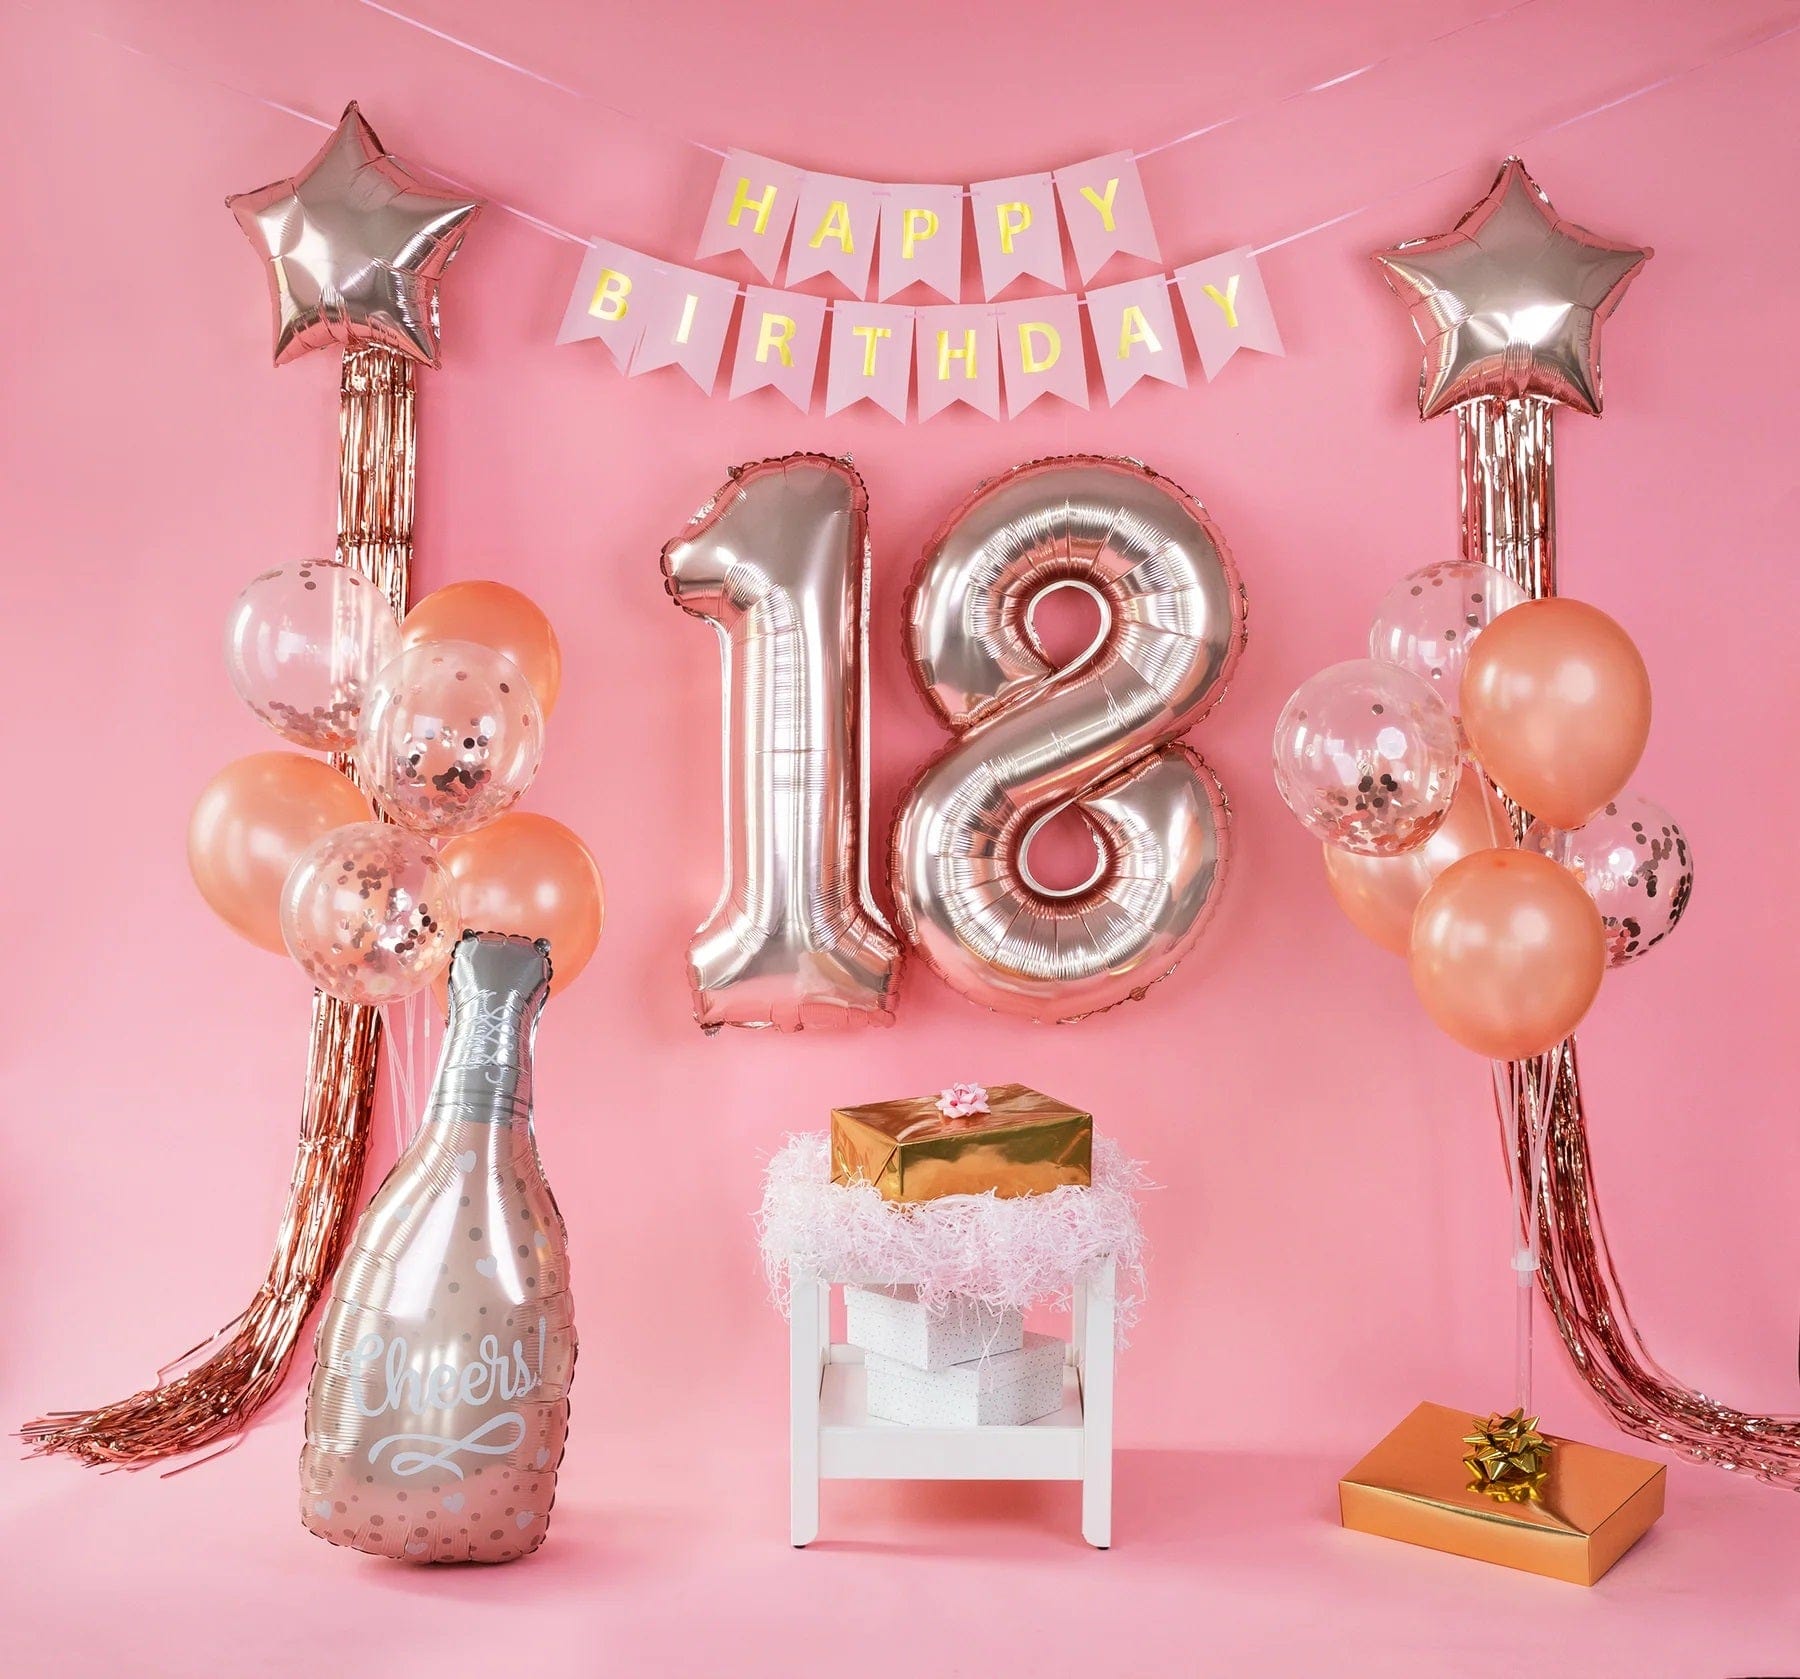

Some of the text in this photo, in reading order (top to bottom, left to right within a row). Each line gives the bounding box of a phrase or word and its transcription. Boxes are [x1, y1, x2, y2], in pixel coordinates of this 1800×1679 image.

[725, 176, 1121, 259] HAPPY
[587, 267, 1242, 380] BIRTHDAY
[660, 451, 1250, 1035] 18
[342, 1316, 546, 1417] Cheers!
